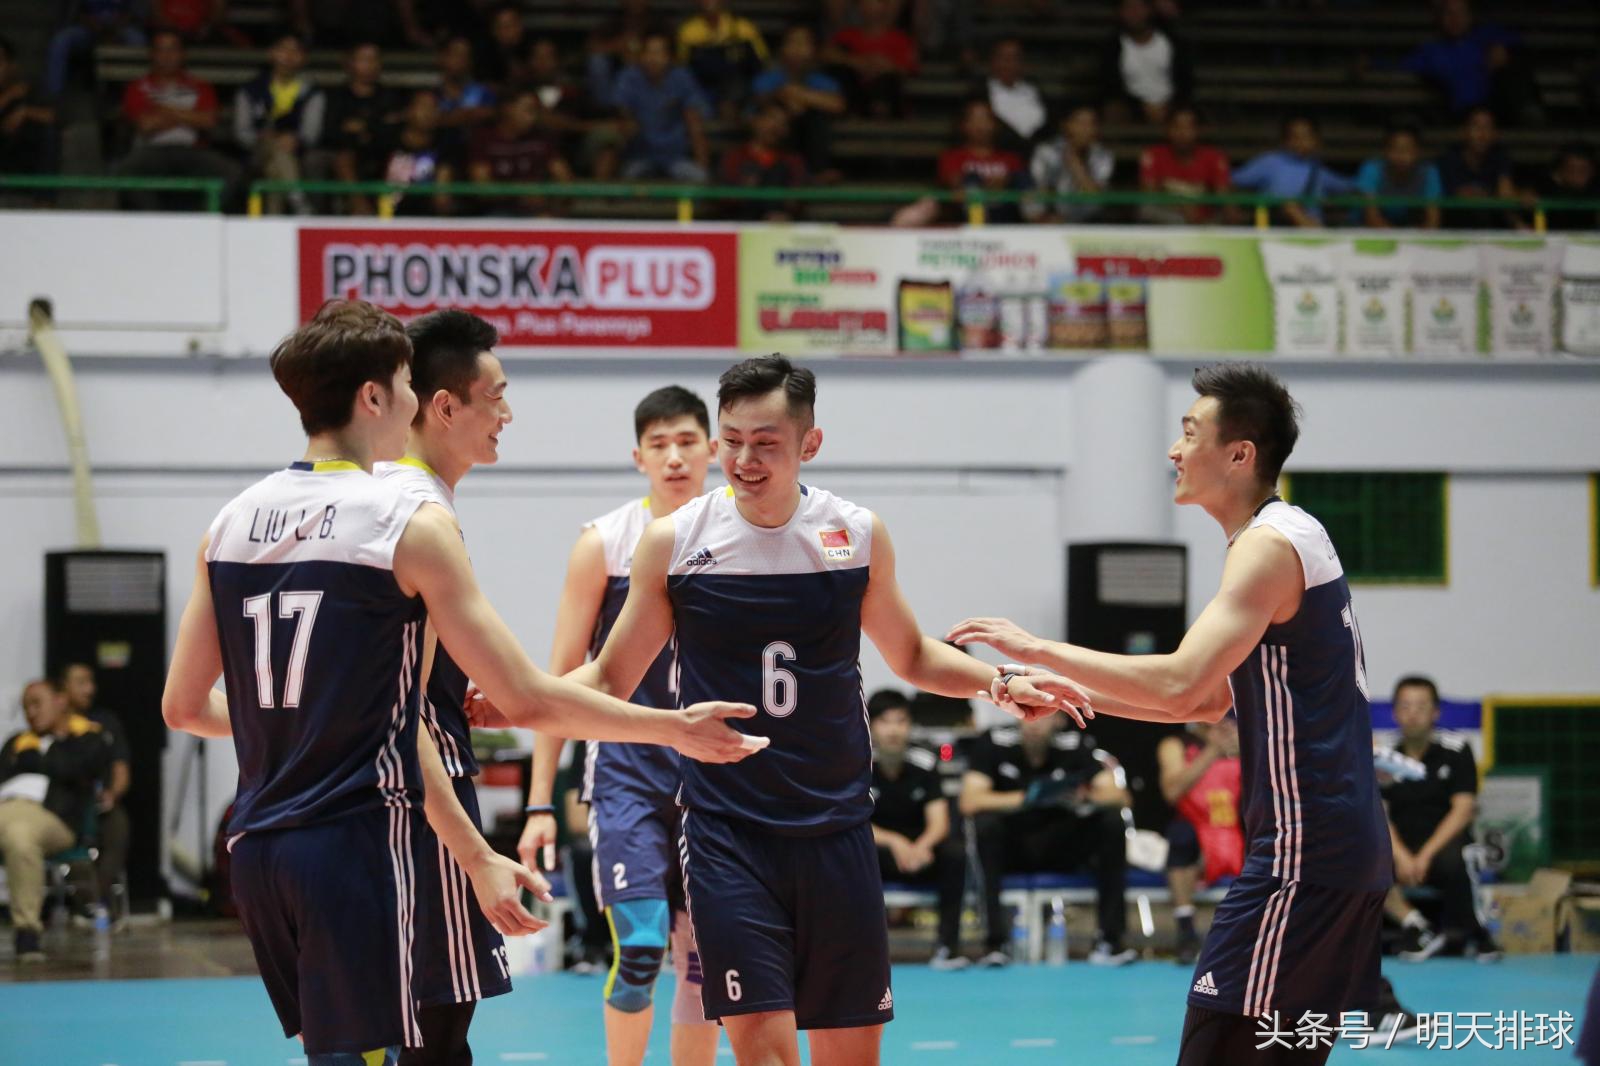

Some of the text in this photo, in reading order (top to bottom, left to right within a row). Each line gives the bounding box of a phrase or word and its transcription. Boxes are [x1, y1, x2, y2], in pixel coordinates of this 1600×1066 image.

[328, 249, 702, 304] PHONSKA PLUS
[248, 507, 288, 543] LIU
[686, 557, 718, 567] adidas
[827, 548, 851, 558] CHN
[243, 590, 324, 709] 17
[761, 640, 798, 718] 6
[612, 862, 628, 890] 2
[725, 968, 743, 1002] 6
